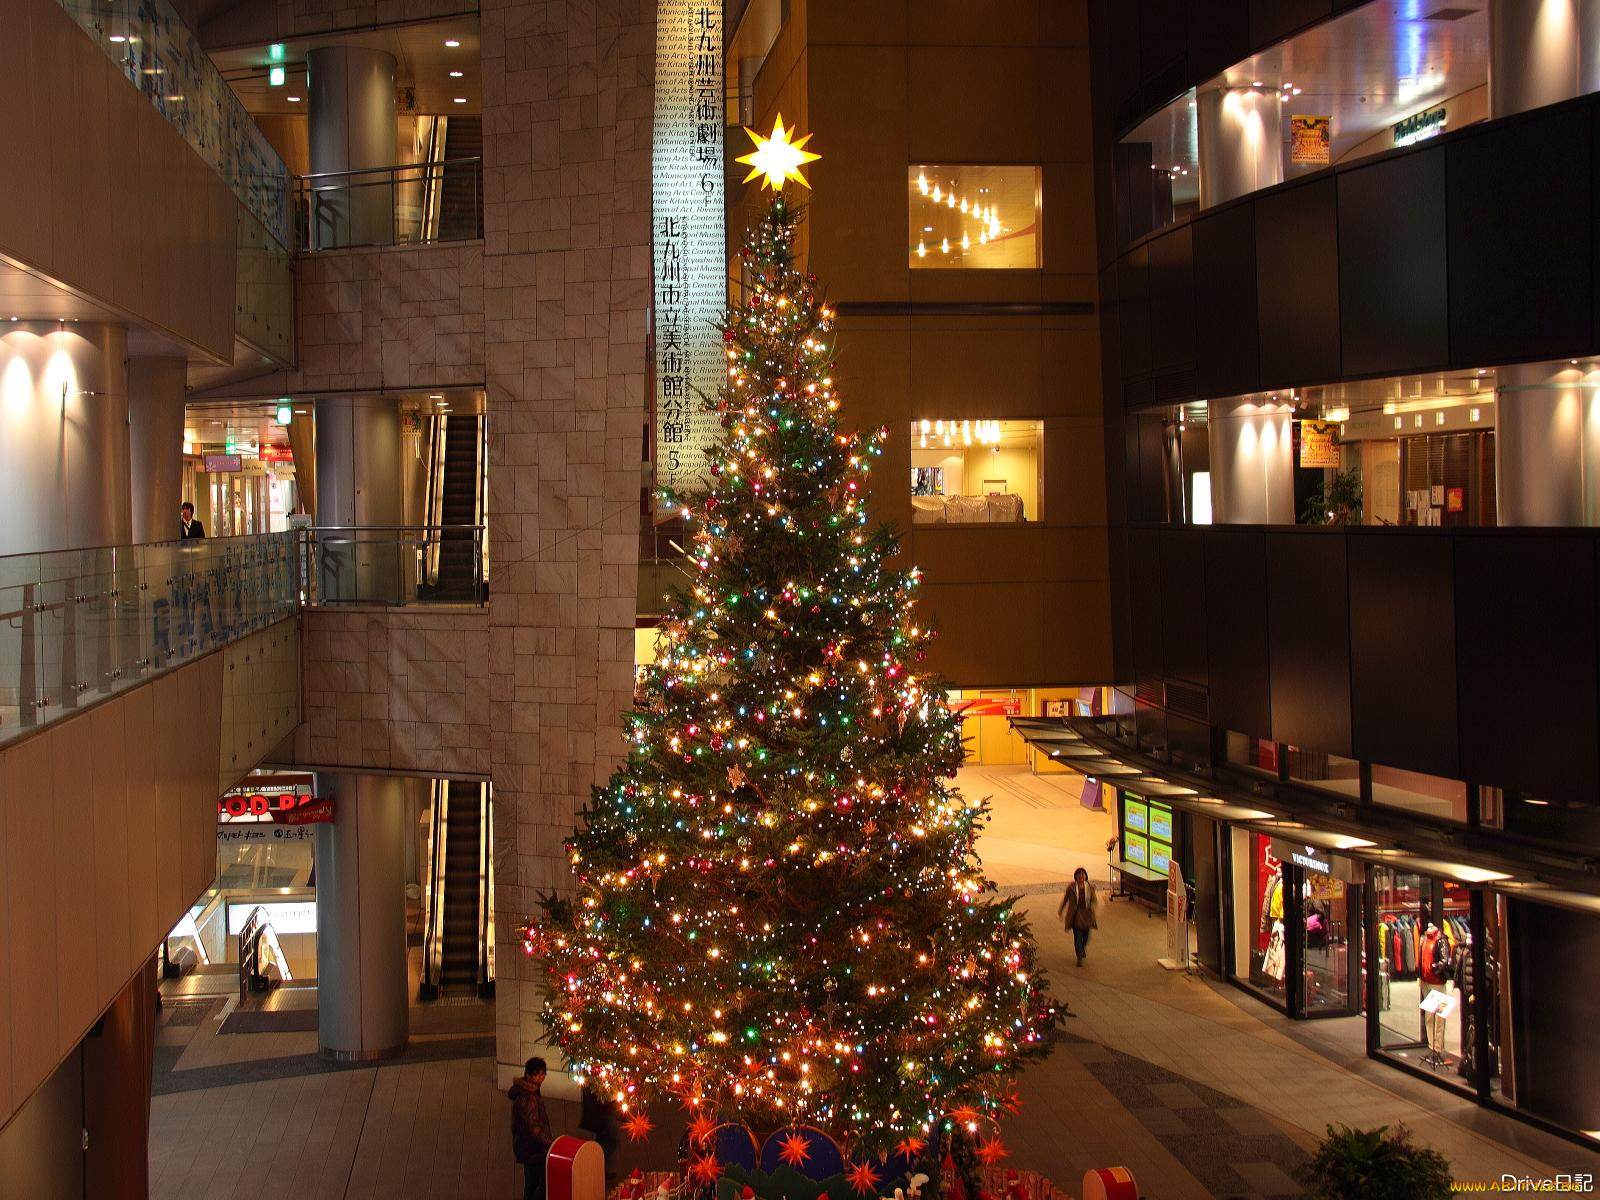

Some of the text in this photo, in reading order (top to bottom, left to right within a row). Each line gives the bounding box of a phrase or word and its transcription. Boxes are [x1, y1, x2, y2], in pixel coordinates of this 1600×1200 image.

[694, 8, 717, 167] 北九州芸術劇場
[660, 216, 684, 443] 北九州市立美術館分館
[218, 794, 270, 817] OD
